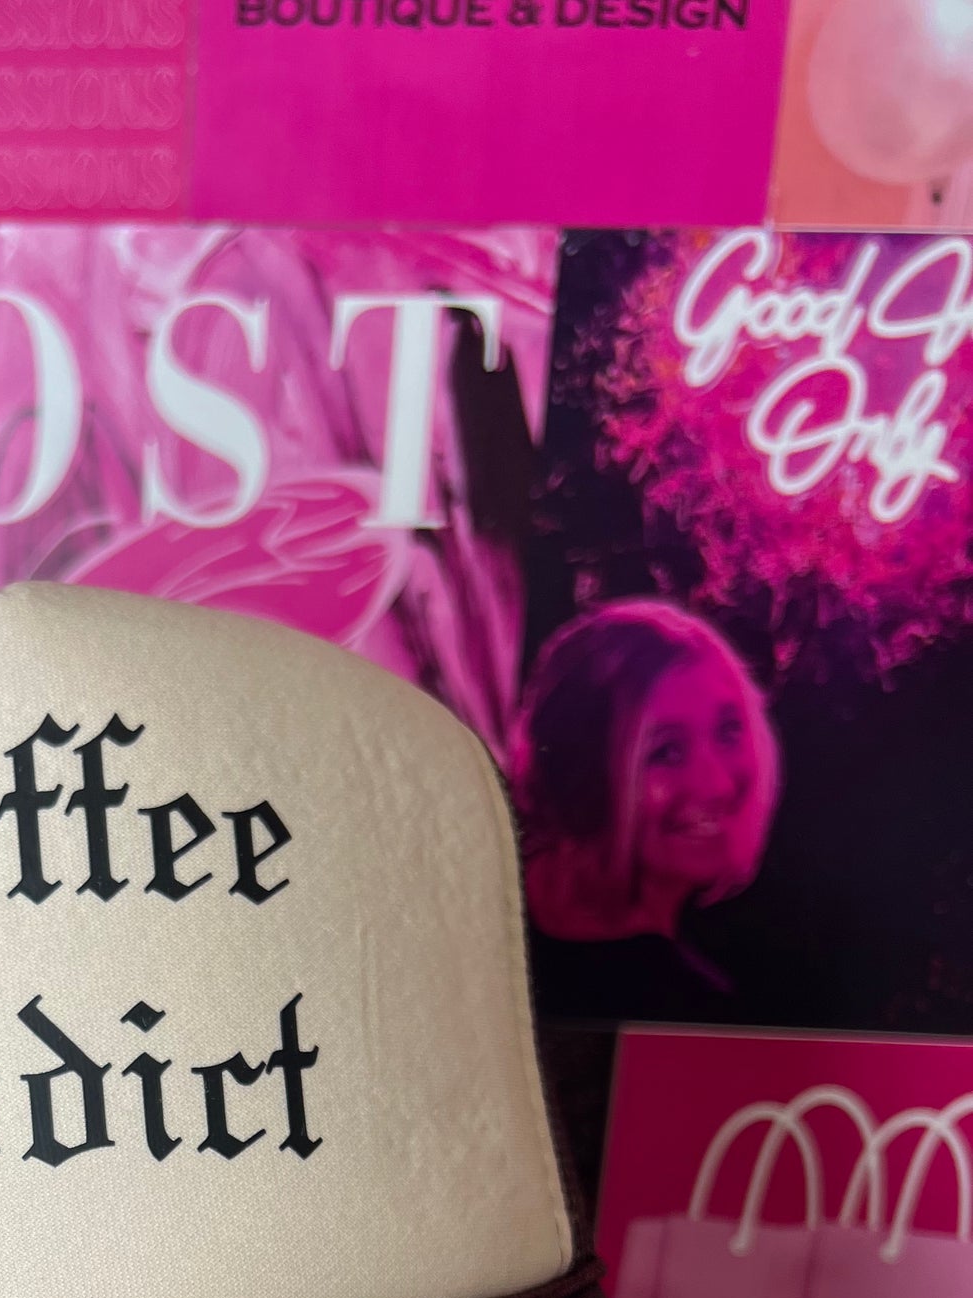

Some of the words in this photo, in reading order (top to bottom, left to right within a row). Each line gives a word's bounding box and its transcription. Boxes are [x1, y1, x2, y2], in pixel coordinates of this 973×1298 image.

[234, 0, 495, 30] BOUTIQUE
[507, 0, 540, 28] &
[554, 0, 749, 30] DESIGN
[673, 226, 880, 388] Good
[746, 352, 960, 523] Only
